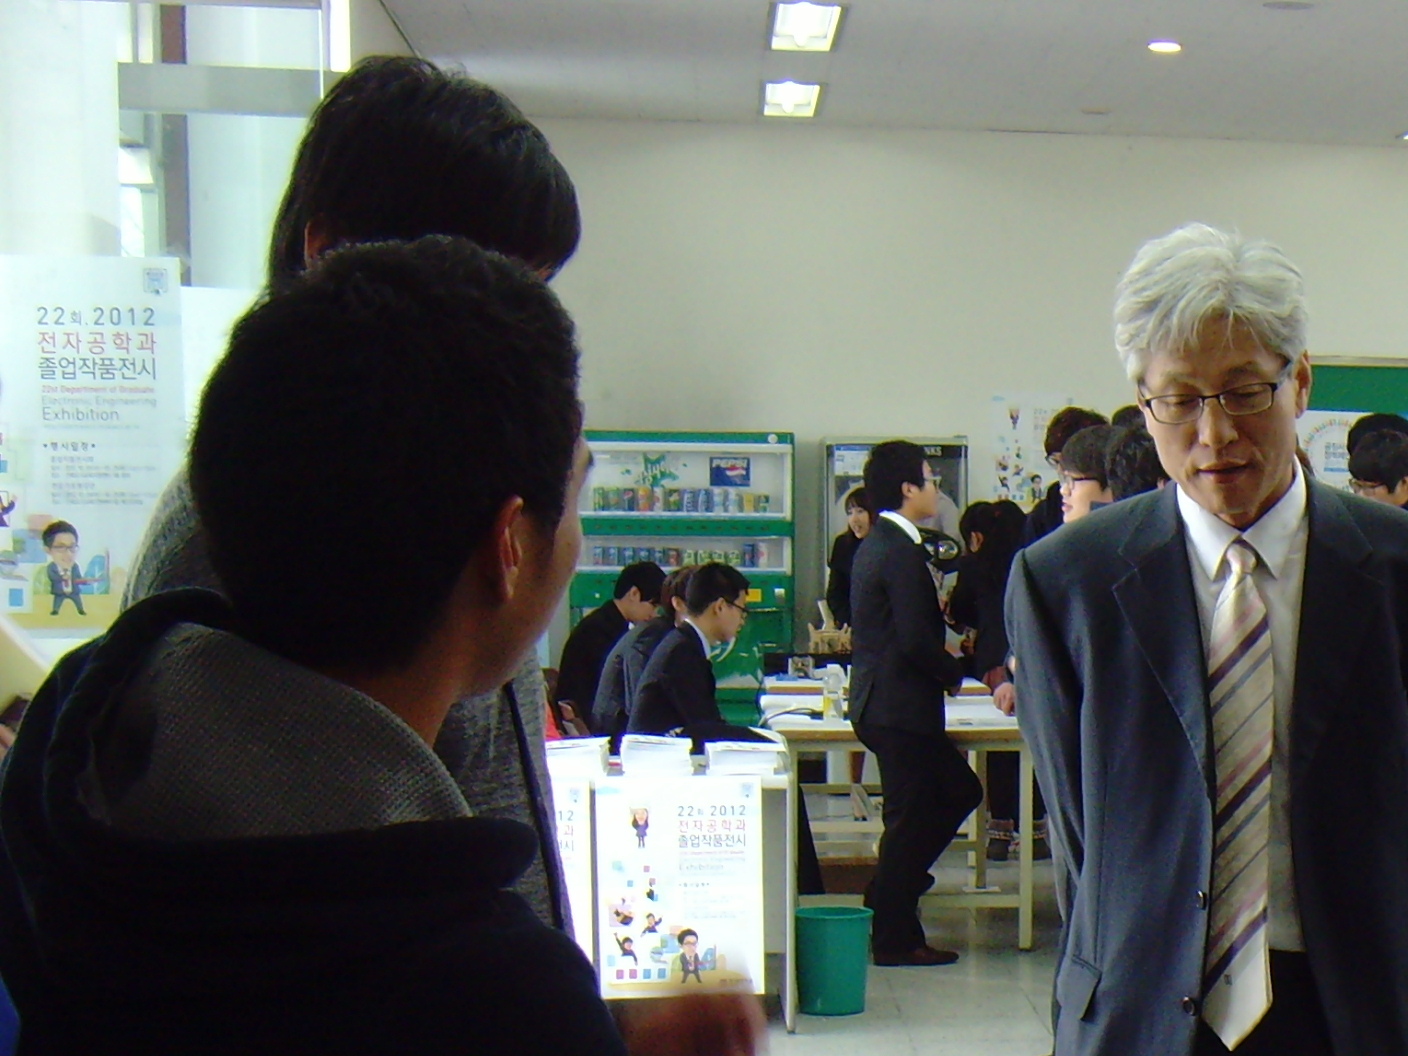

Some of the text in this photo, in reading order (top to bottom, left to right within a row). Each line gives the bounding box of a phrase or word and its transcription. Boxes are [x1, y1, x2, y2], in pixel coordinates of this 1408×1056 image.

[37, 331, 157, 355] 전자공학과
[38, 357, 156, 380] 졸업작품전시
[42, 406, 119, 421] Exhibition
